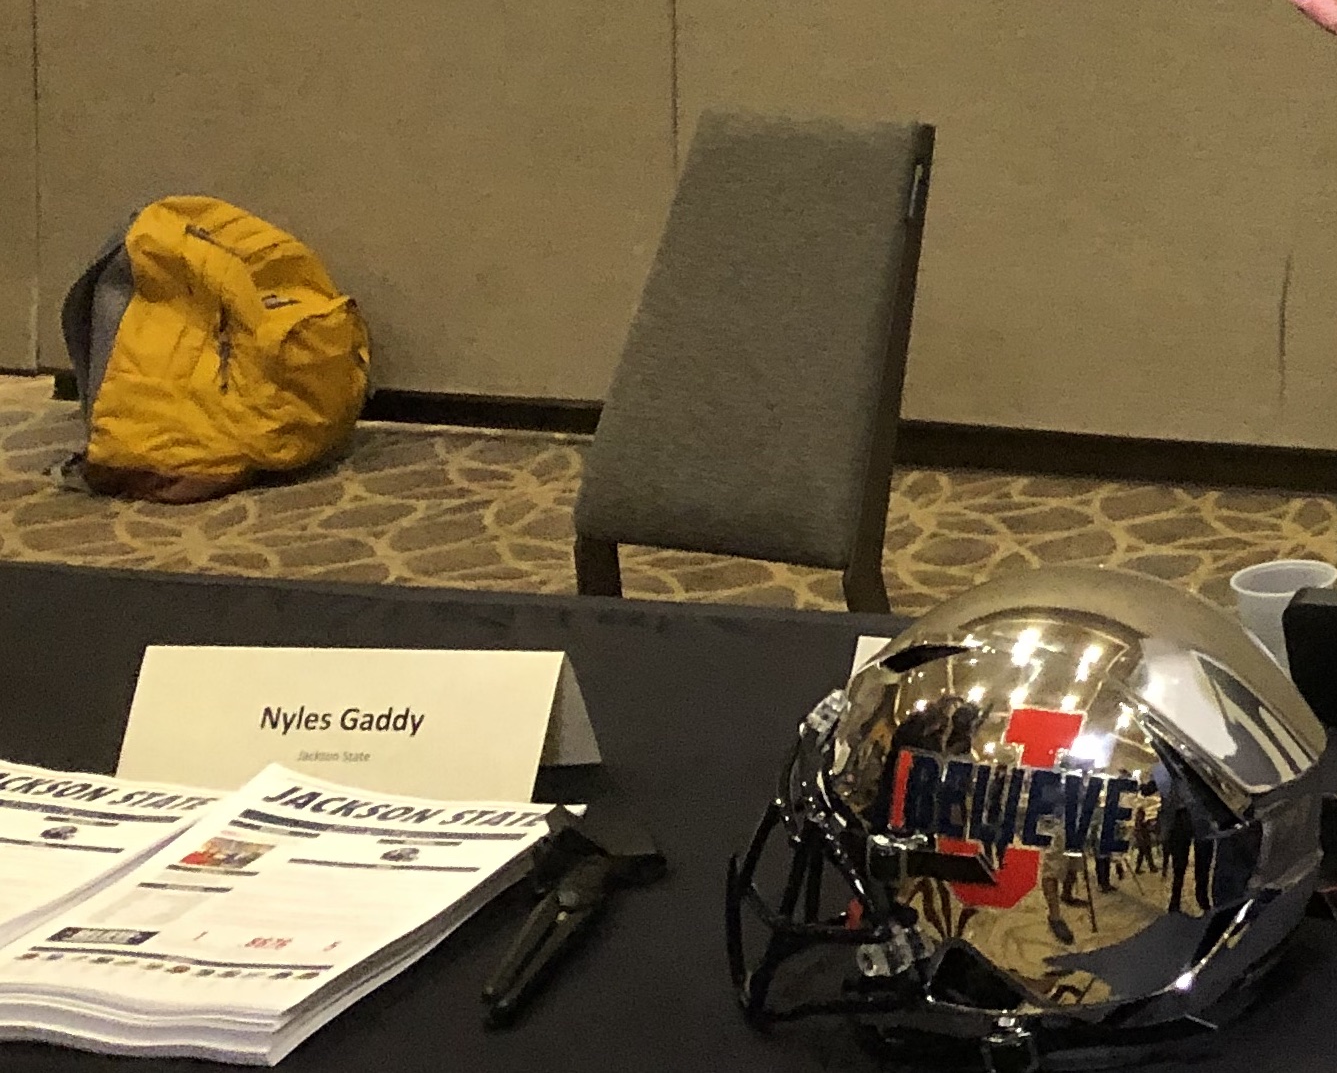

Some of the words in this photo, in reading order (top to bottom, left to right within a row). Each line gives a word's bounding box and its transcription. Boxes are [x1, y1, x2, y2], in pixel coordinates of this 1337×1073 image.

[260, 705, 333, 736] Nyles
[339, 706, 426, 738] Gaddy
[297, 750, 340, 762] Jackson
[342, 750, 371, 763] State
[262, 785, 446, 825] JACKSON
[438, 803, 548, 828] STATE
